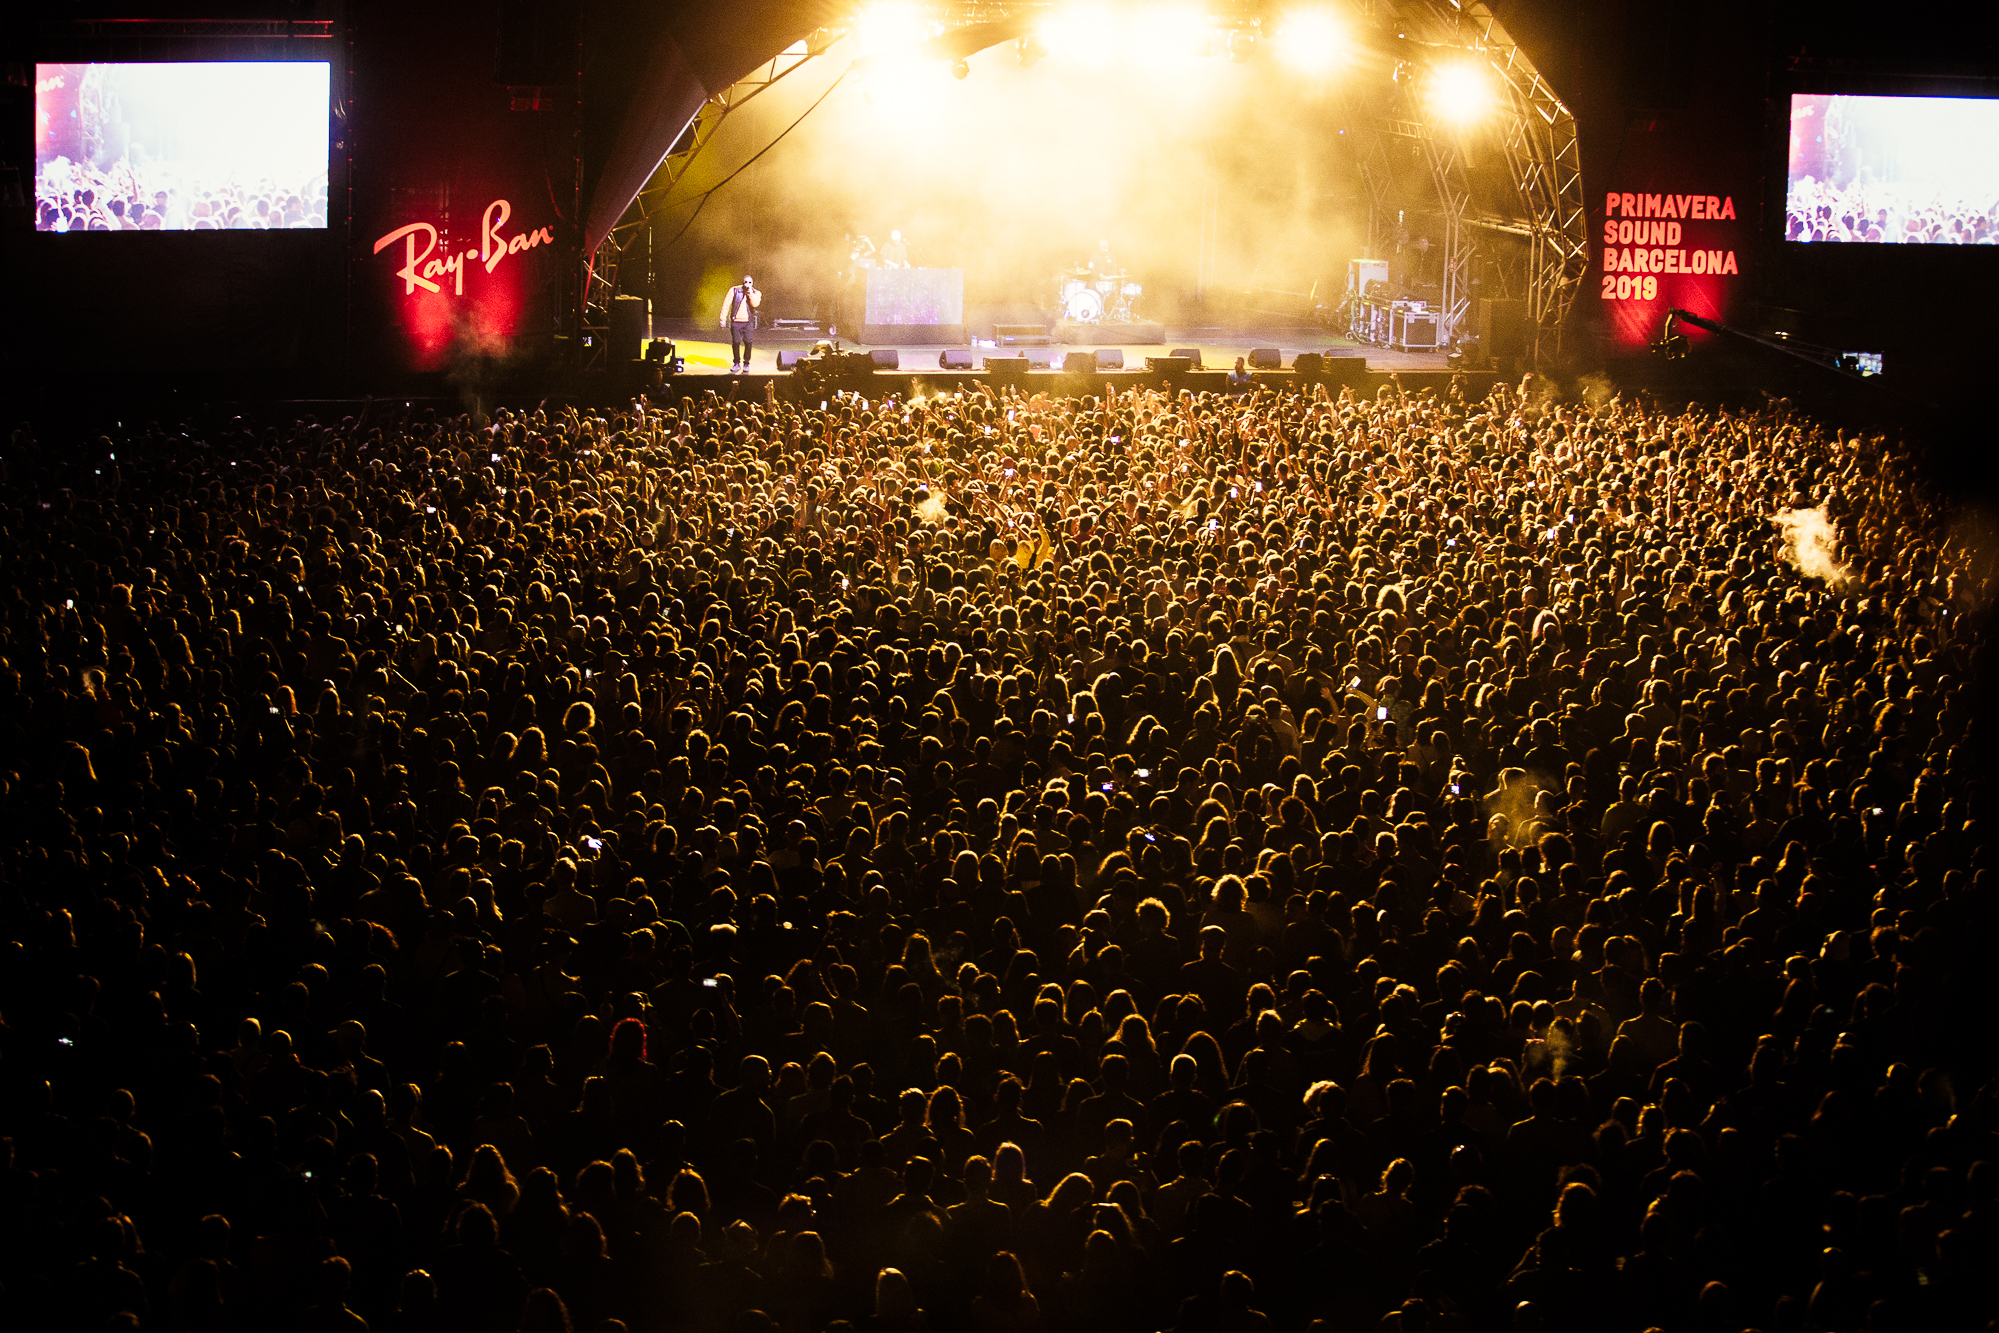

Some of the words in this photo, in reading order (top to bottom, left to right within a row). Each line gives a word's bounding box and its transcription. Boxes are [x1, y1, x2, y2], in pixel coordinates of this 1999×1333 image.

[1605, 192, 1737, 220] PRIMAVERA
[1603, 219, 1682, 246] SOUND
[1603, 247, 1739, 275] BARCELONA
[1601, 274, 1658, 300] 2019
